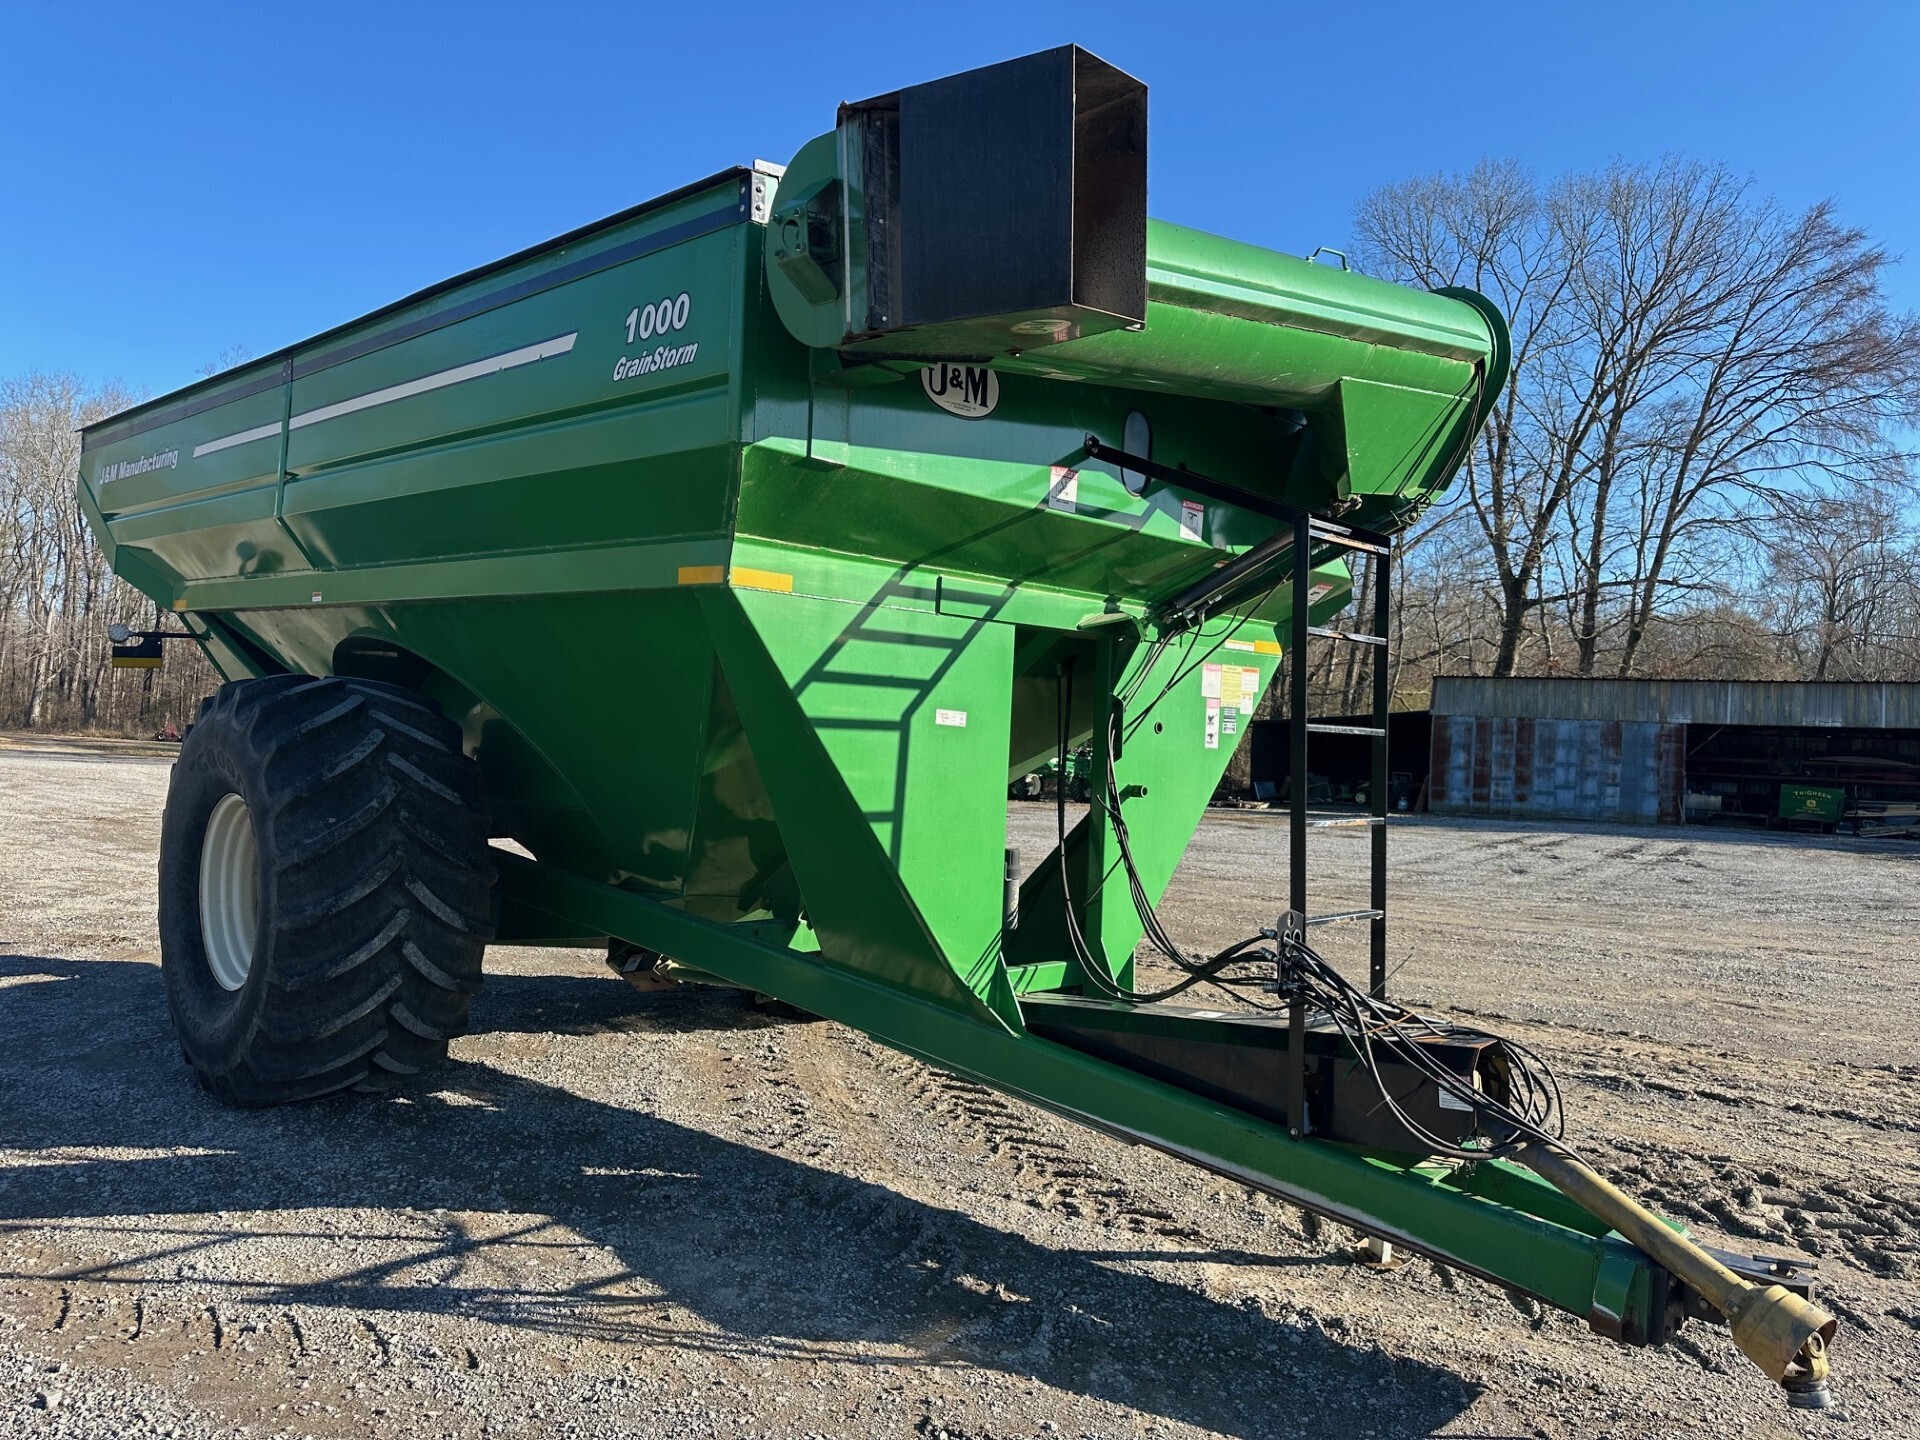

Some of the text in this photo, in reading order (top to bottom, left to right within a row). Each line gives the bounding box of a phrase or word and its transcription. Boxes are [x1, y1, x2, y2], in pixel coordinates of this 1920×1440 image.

[625, 293, 690, 343] 1000
[613, 342, 698, 381] GrainStorm
[99, 449, 179, 485] J&M Manufacturing
